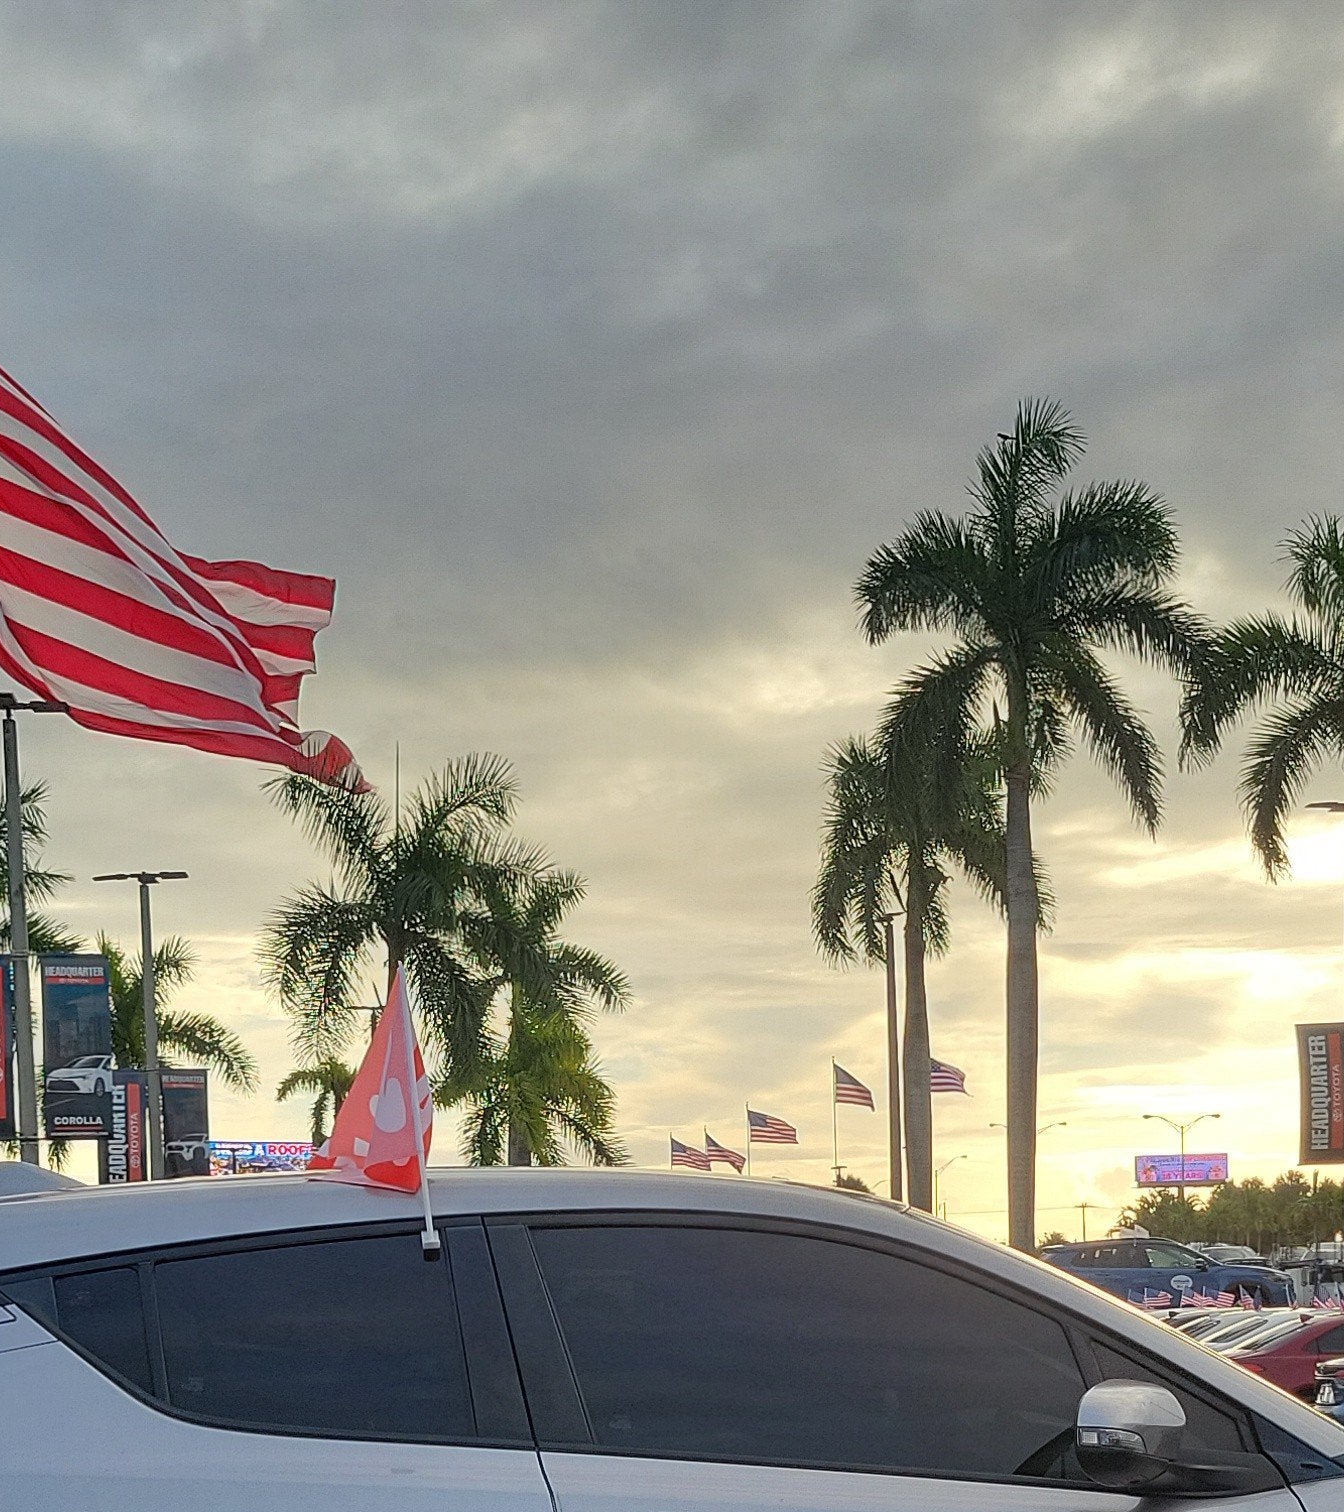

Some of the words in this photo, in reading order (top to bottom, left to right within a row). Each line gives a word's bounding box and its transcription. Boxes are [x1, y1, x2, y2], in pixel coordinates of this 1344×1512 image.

[54, 1116, 104, 1125] COROLLA
[1308, 1035, 1331, 1150] HEADQUARTER
[1332, 1064, 1342, 1107] TOYOTA
[108, 1084, 129, 1184] EADQUARTER
